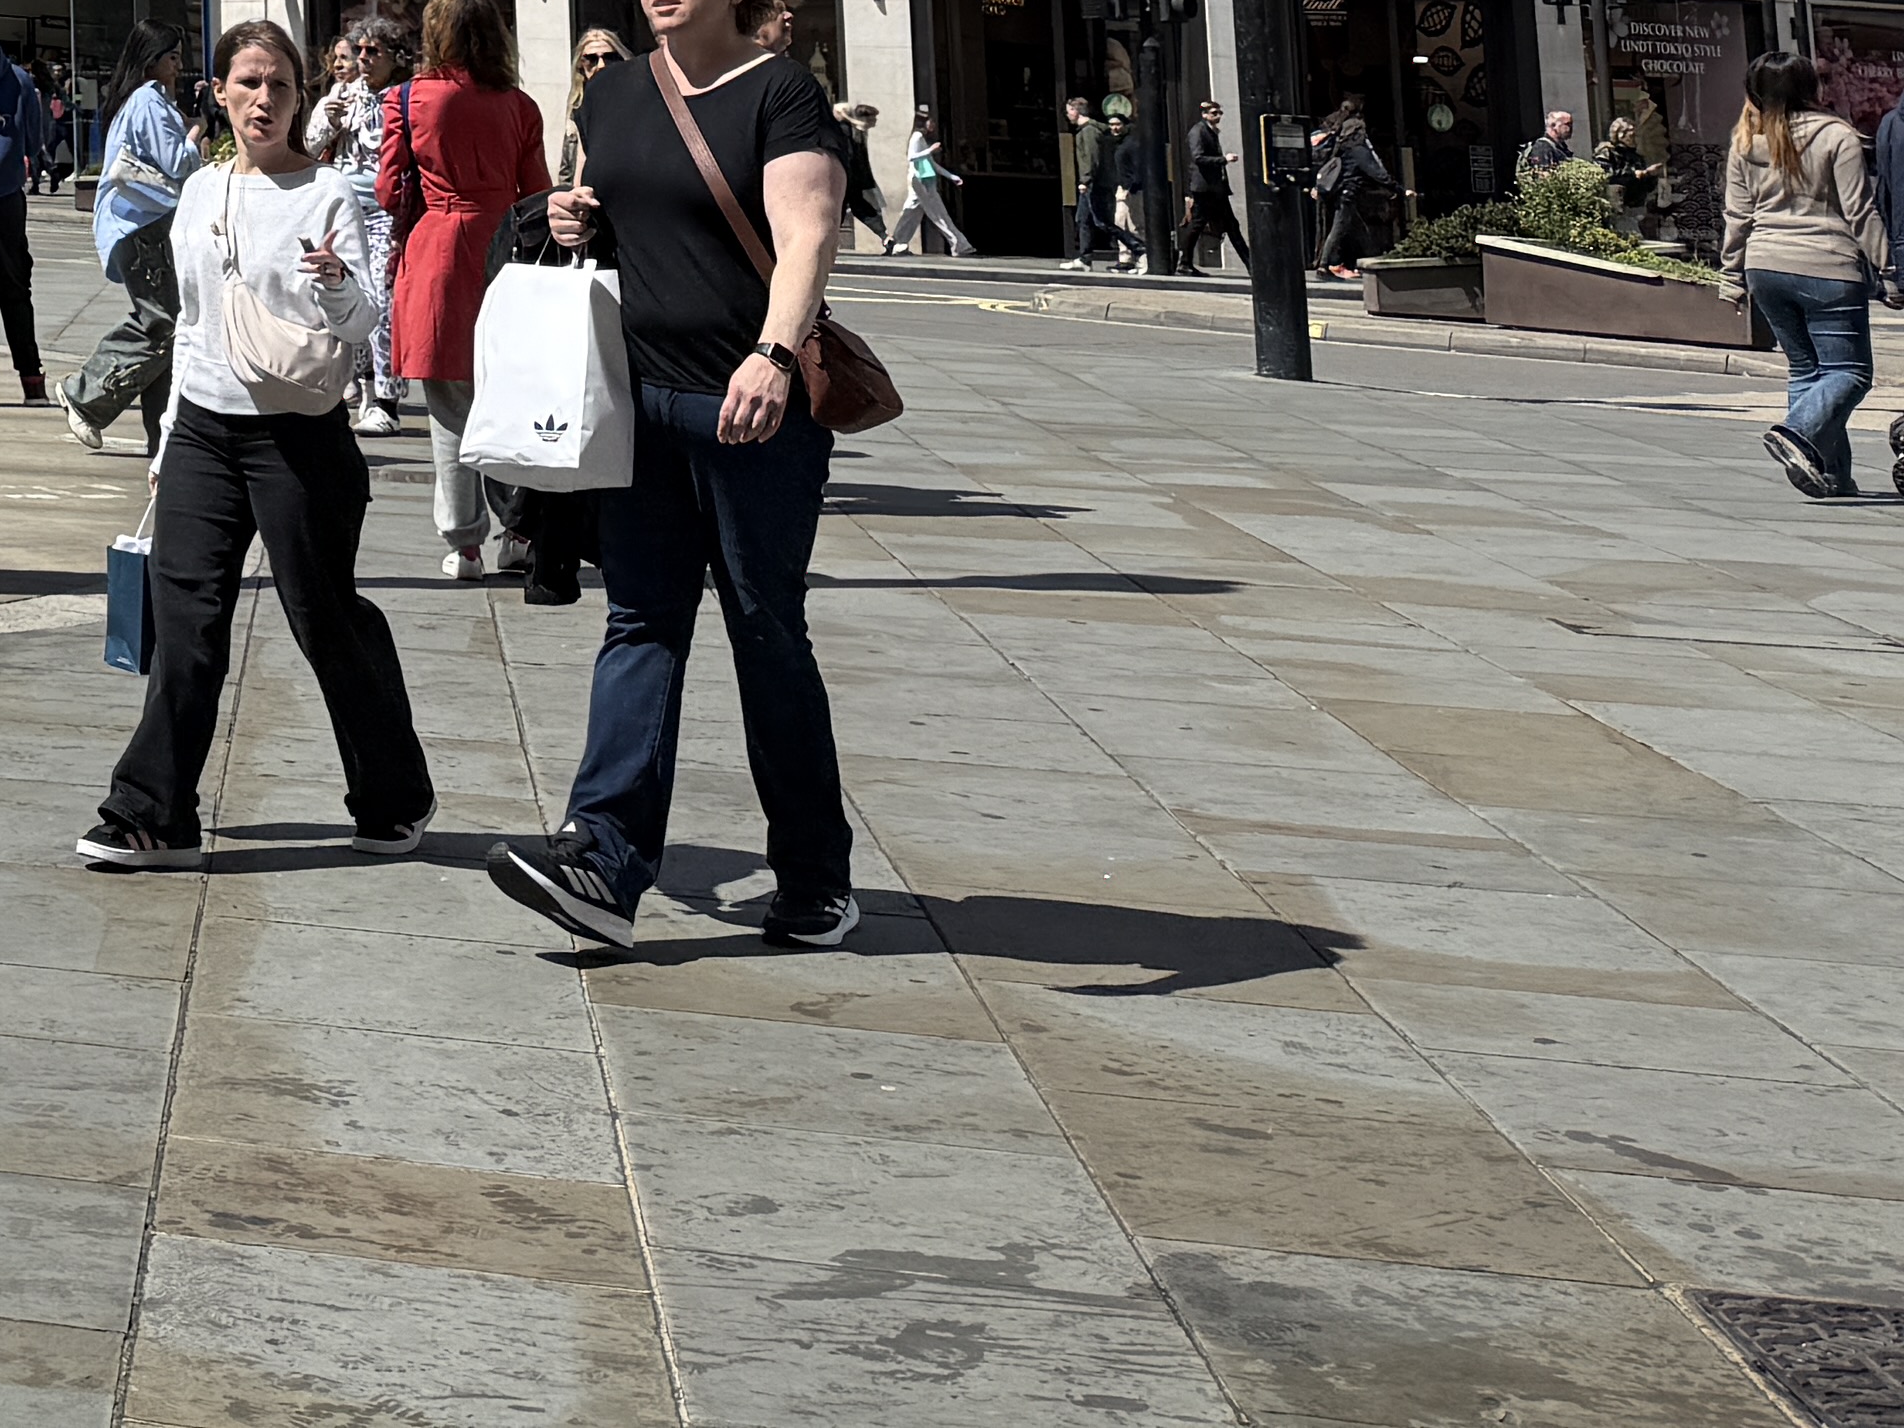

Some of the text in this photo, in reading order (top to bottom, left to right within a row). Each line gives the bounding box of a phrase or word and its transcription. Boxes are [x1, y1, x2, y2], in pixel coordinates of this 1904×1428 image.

[1630, 21, 1710, 39] DISCOVER NEW
[1656, 41, 1692, 58] TOKYO
[1693, 44, 1722, 58] STYLE
[1641, 58, 1705, 75] CHOCOLATE
